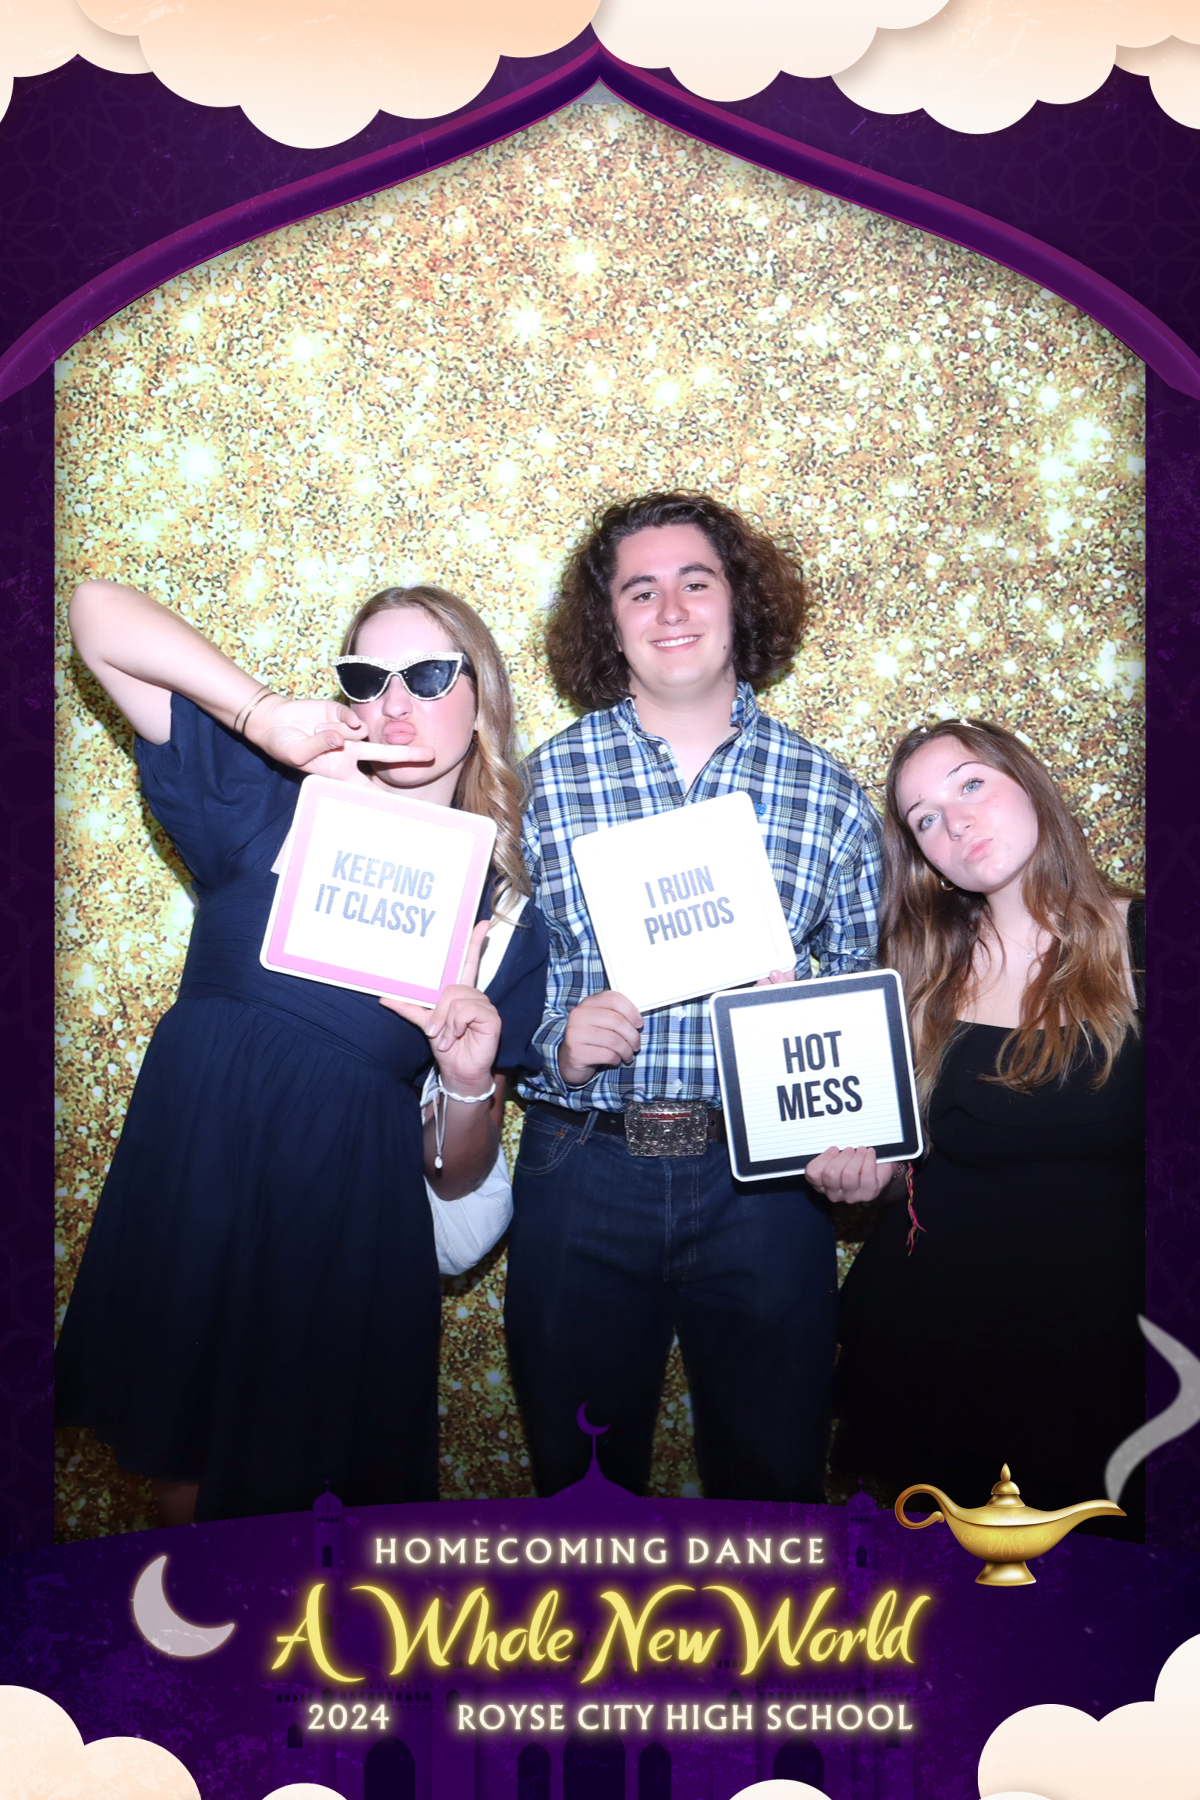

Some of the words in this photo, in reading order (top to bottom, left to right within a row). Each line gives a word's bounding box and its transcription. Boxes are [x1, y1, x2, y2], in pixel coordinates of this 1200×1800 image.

[331, 850, 435, 901] KEEPING
[644, 881, 657, 909] I
[658, 865, 715, 904] RUIN
[314, 883, 341, 915] IT
[342, 890, 437, 938] CLASSY
[643, 896, 735, 945] PHOTOS
[782, 1030, 843, 1074] HOT
[776, 1075, 863, 1122] MESS
